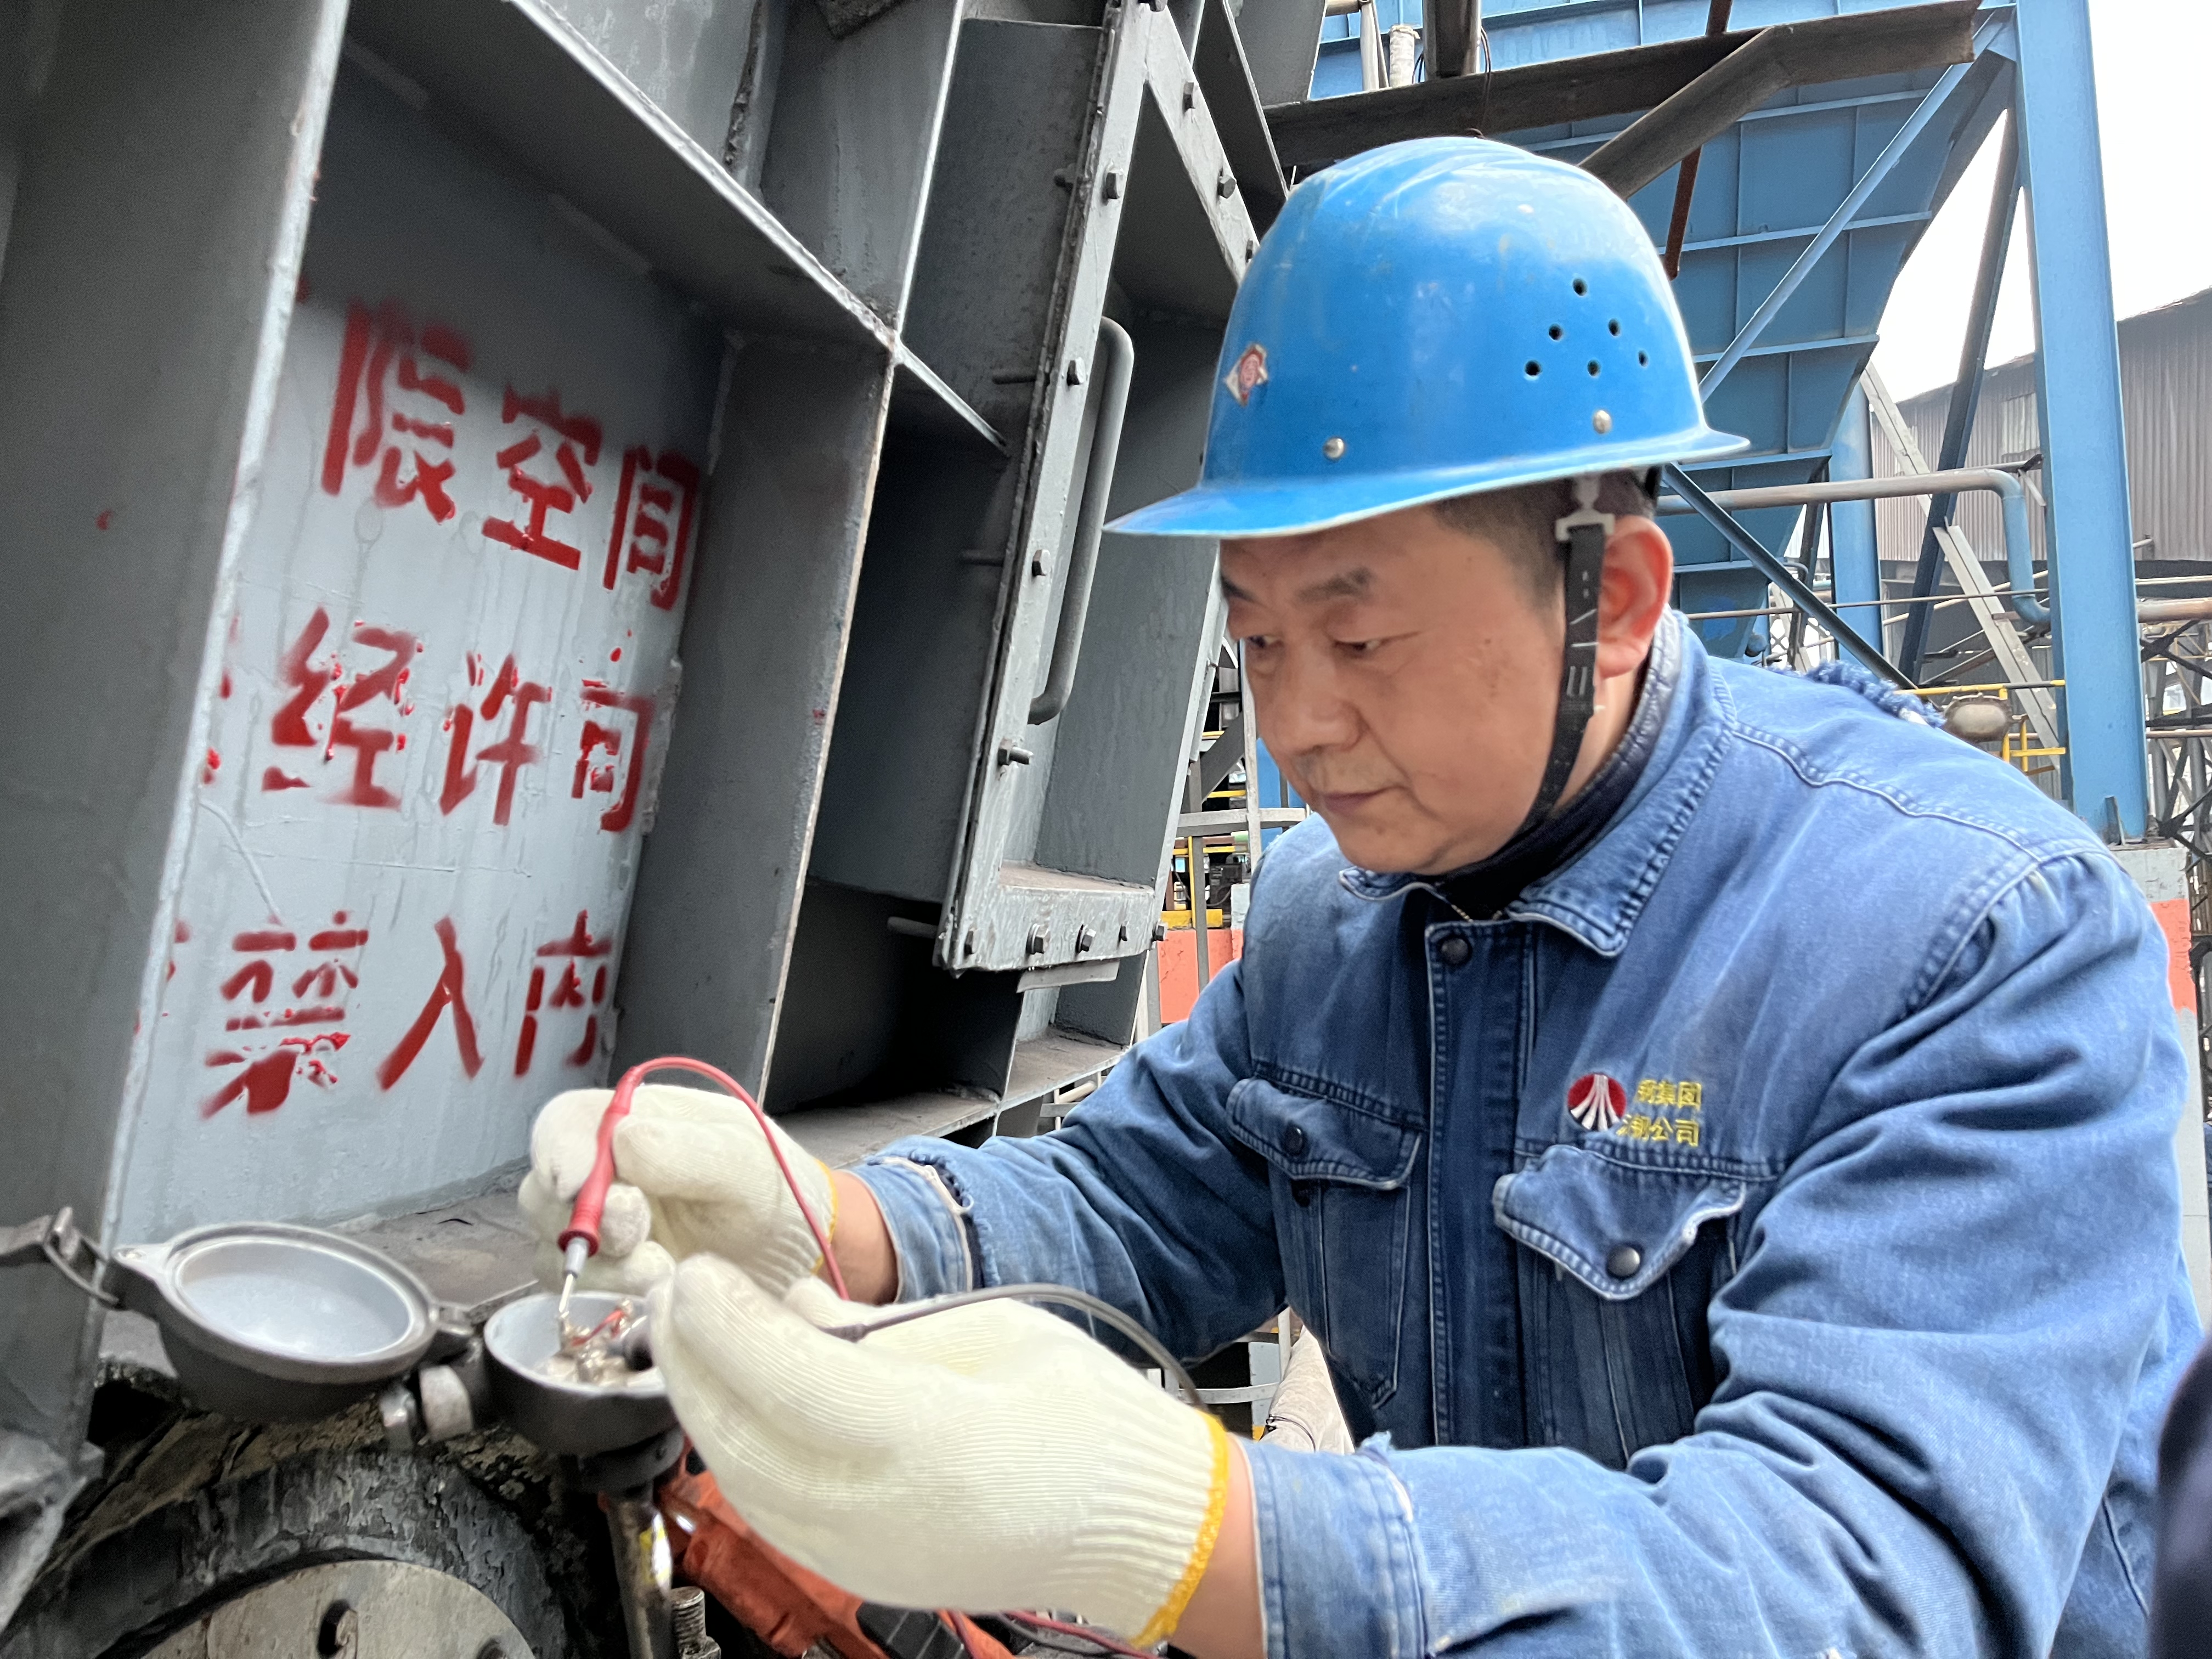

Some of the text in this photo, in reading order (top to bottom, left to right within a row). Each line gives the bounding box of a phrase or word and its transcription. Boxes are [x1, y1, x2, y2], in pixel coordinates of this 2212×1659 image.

[296, 275, 700, 610] 限空间
[201, 606, 654, 833] 经许可
[166, 910, 613, 1118] 禁入内
